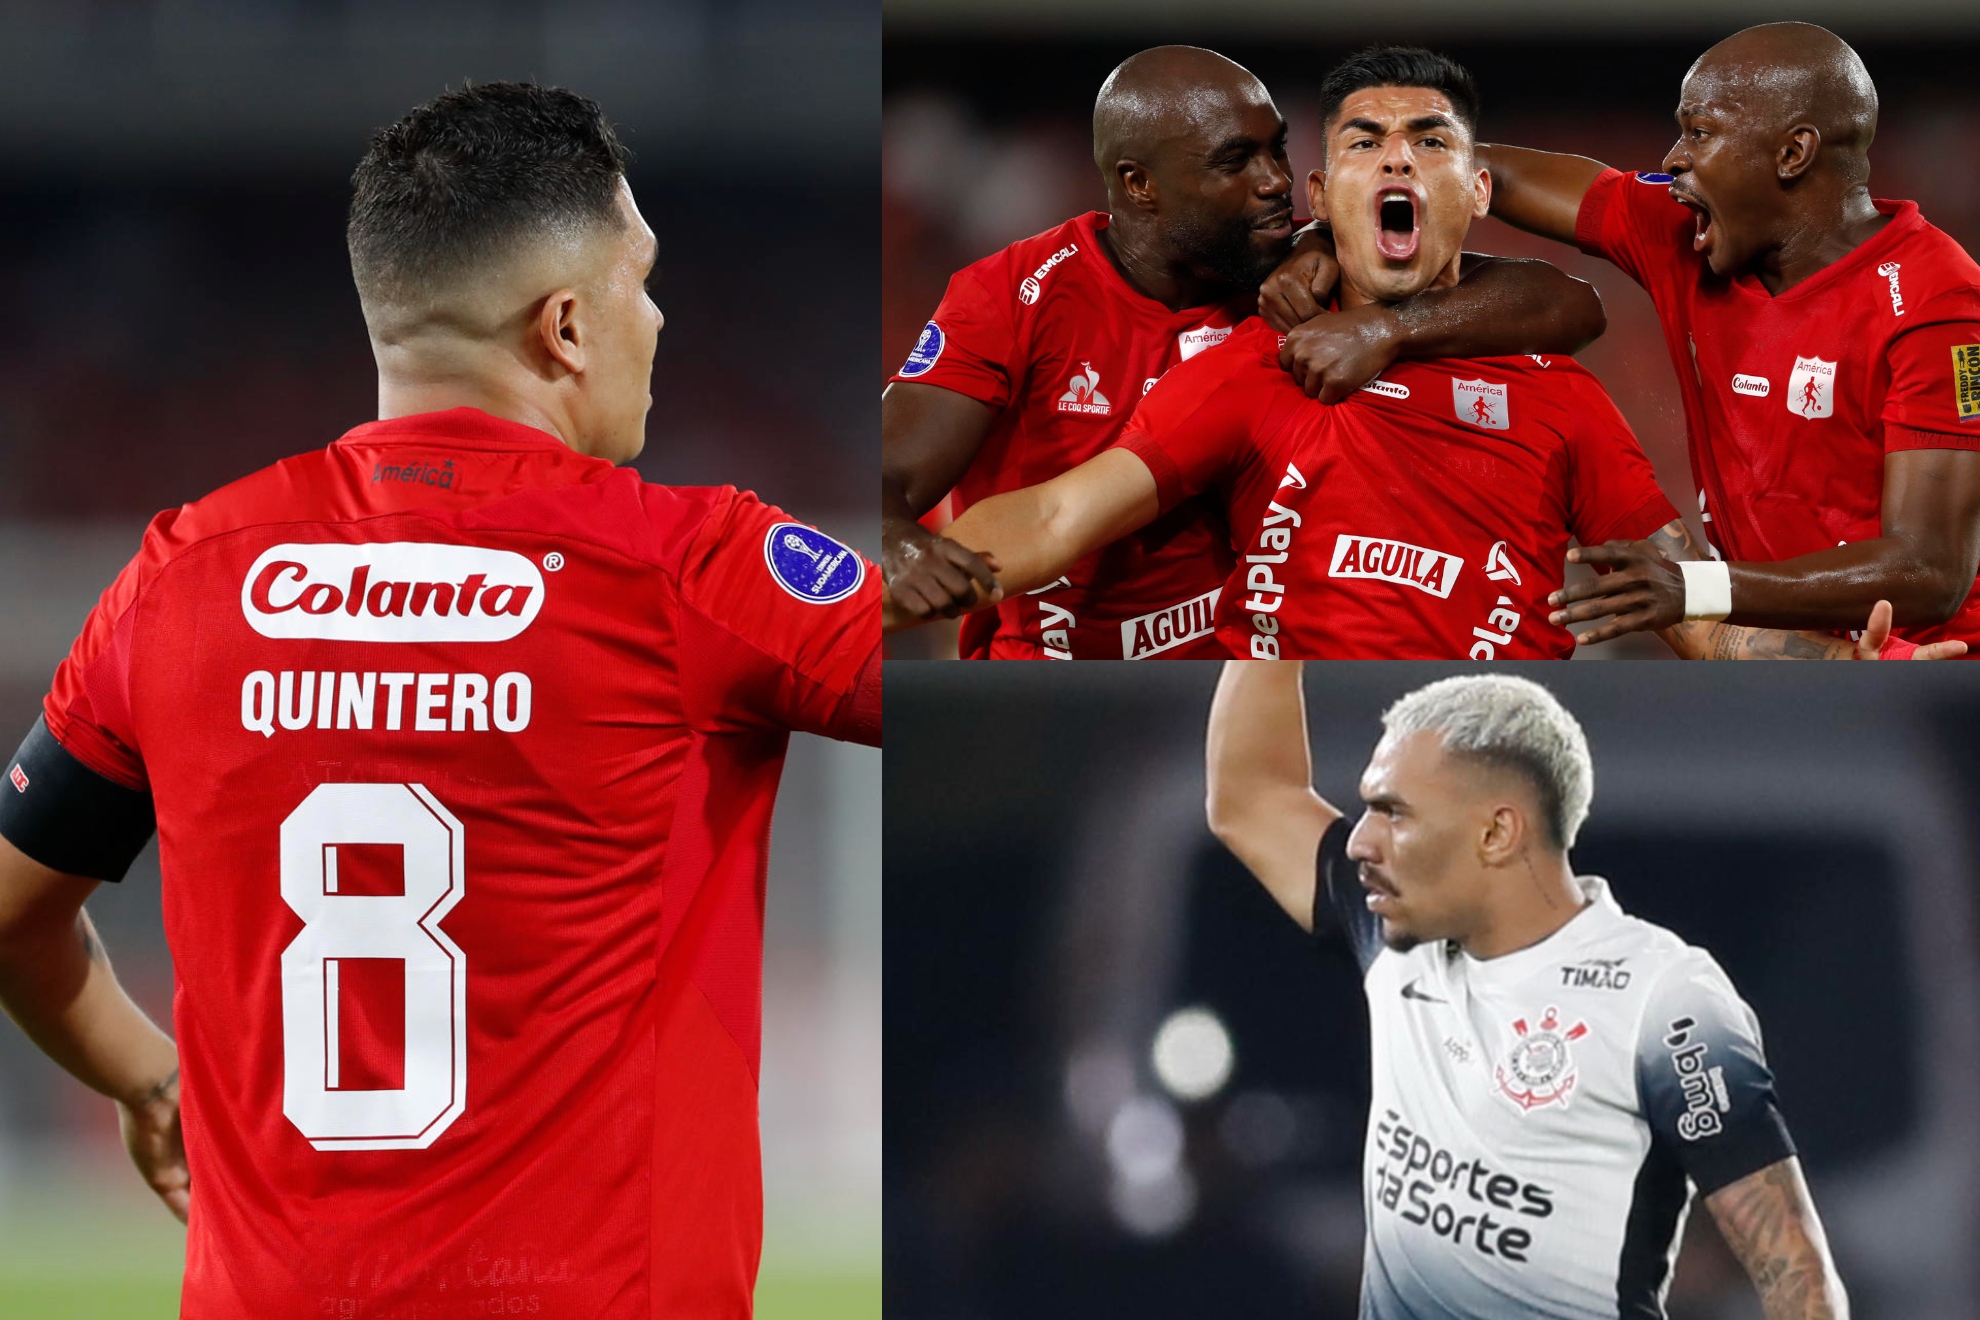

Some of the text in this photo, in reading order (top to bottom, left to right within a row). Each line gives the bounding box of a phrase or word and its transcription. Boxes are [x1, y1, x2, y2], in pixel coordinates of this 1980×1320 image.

[1034, 244, 1079, 280] EMCALI
[1889, 271, 1905, 316] EMCALI
[1184, 332, 1228, 344] América
[1457, 381, 1503, 396] América
[1733, 377, 1768, 392] Colanta
[1797, 361, 1832, 375] América
[1958, 369, 1969, 403] FREDDY
[1058, 402, 1110, 415] LE COQ SPORTIF
[370, 461, 454, 489] América
[1245, 500, 1301, 660] BetPlay
[1336, 539, 1448, 592] AGUILA
[251, 559, 534, 618] Colanta
[1131, 596, 1215, 659] AGUIL
[241, 670, 532, 738] QUINTERO
[280, 783, 467, 1152] 8
[1671, 1042, 1722, 1140] bmg
[1400, 1180, 1532, 1263] Sorte
